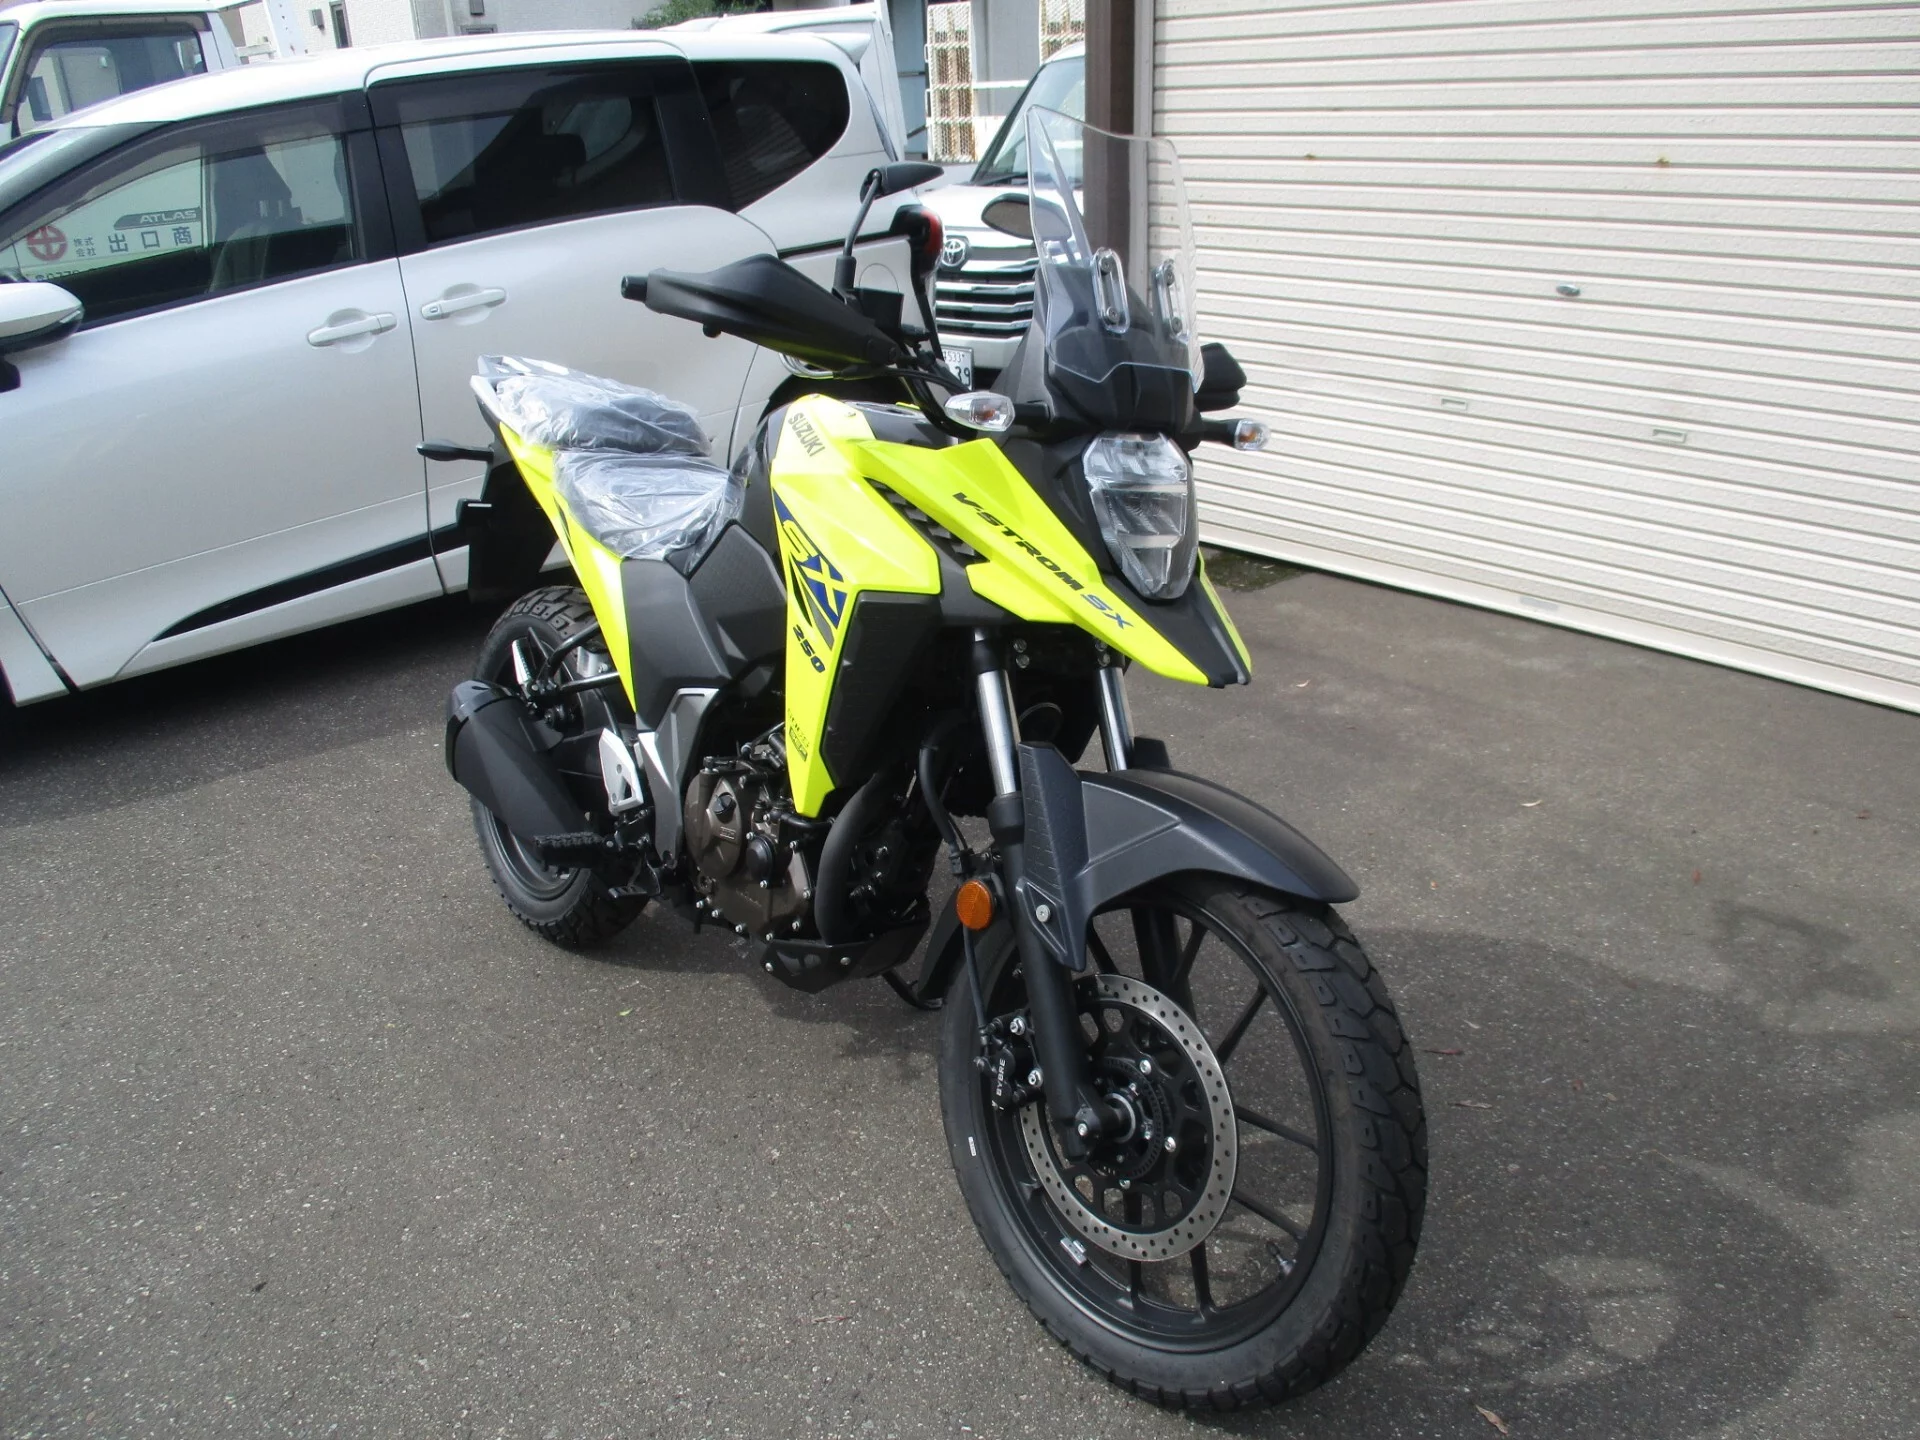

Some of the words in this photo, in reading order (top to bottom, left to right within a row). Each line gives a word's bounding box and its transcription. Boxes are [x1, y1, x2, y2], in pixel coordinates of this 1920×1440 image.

[140, 209, 197, 223] ATLAS
[75, 247, 97, 258] 会社
[108, 226, 193, 252] 出口商
[788, 412, 826, 457] SUZUKI
[782, 519, 848, 617] SX
[952, 492, 1084, 591] V-STROM
[1080, 593, 1135, 630] SX
[792, 624, 826, 673] 250
[996, 1058, 1006, 1096] BYBRE
